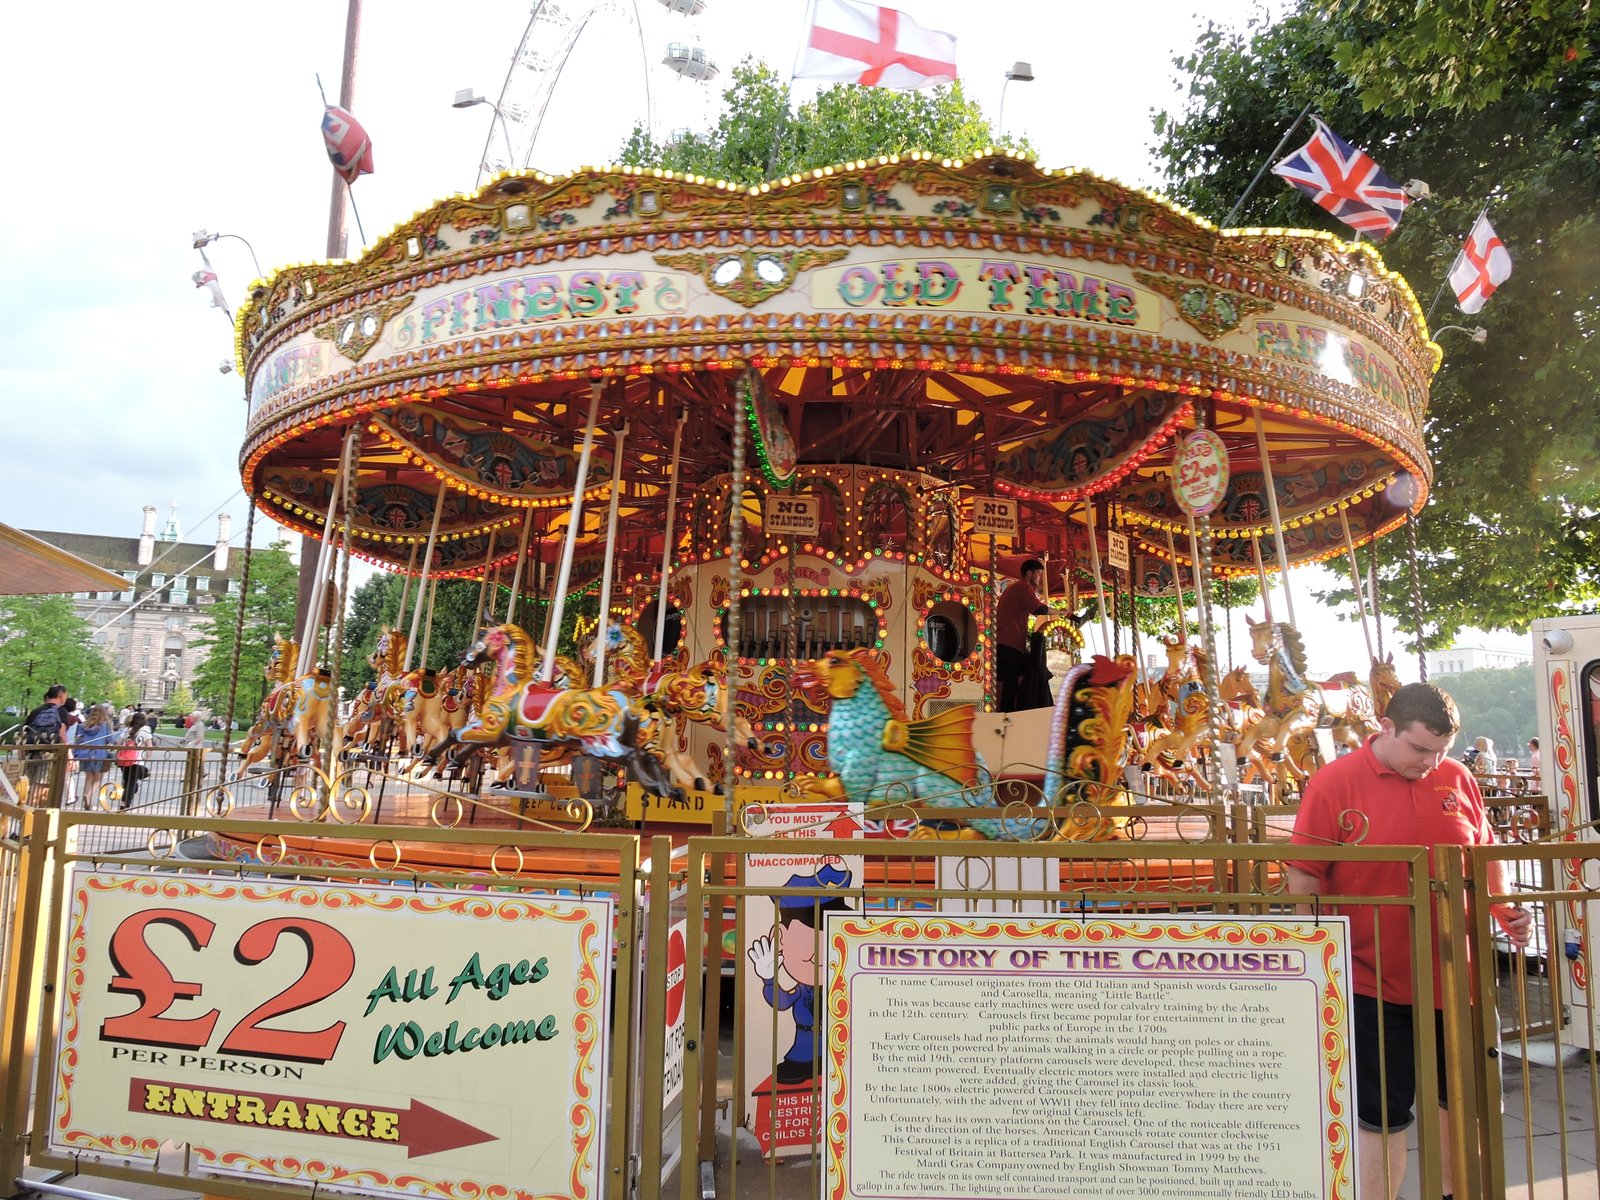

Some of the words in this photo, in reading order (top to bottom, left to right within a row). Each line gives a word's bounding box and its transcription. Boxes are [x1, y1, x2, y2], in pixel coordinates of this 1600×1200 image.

[838, 261, 962, 307] OLD
[981, 259, 1140, 325] TIME
[421, 271, 650, 344] FINEST
[777, 501, 808, 514] NO
[983, 502, 1008, 516] NO
[770, 514, 814, 528] STANDING
[977, 515, 1014, 530] STANDING
[768, 816, 790, 824] YOU
[793, 815, 823, 824] MUST
[793, 829, 816, 838] THIS
[749, 856, 841, 867] UNACCOMPANIED
[867, 945, 998, 968] HISTORY
[1010, 949, 1049, 968] OF
[1060, 951, 1120, 969] THE
[1131, 951, 1299, 972] CAROUSEL
[100, 908, 356, 1065] £2
[363, 965, 438, 1018] All
[446, 952, 550, 1006] Ages
[880, 976, 898, 987] The
[930, 977, 973, 988] Carousel
[976, 978, 1025, 991] originates
[1028, 978, 1052, 989] from
[1055, 978, 1071, 989] the
[1073, 978, 1092, 989] Old
[1096, 979, 1128, 990] Italian
[1131, 979, 1150, 990] and
[1153, 980, 1193, 994] Spanish
[1196, 980, 1227, 991] words
[1229, 980, 1278, 992] Garosello
[980, 988, 1000, 998] and
[1054, 990, 1098, 1003] meaning
[888, 997, 908, 1008] This
[932, 998, 972, 1008] because
[974, 998, 999, 1012] early
[1001, 998, 1048, 1010] machines
[1077, 1000, 1100, 1010] used
[1103, 1000, 1118, 1011] for
[1163, 1002, 1204, 1015] training
[1206, 1002, 1218, 1015] by
[1221, 1002, 1238, 1012] the
[1240, 1002, 1270, 1013] Arabs
[989, 1021, 1020, 1035] public
[1023, 1021, 1050, 1035] parks
[1053, 1021, 1063, 1032] of
[1066, 1022, 1102, 1035] Europe
[1105, 1023, 1115, 1032] in
[1118, 1022, 1134, 1033] the
[1138, 1022, 1168, 1033] 1700s
[373, 1014, 560, 1064] Welcome
[884, 1031, 910, 1045] Early
[912, 1031, 961, 1042] Carousels
[964, 1032, 982, 1043] had
[1056, 1033, 1072, 1044] the
[1074, 1034, 1114, 1045] animals
[1116, 1034, 1148, 1045] would
[1151, 1035, 1176, 1049] hang
[1194, 1035, 1221, 1049] poles
[111, 1046, 169, 1066] PER
[179, 1053, 304, 1080] PERSON
[872, 1052, 885, 1066] By
[888, 1052, 904, 1063] the
[907, 1052, 926, 1063] mid
[958, 1055, 997, 1068] century
[1000, 1054, 1044, 1068] platform
[1046, 1055, 1092, 1066] carousels
[1178, 1057, 1205, 1068] these
[1208, 1057, 1256, 1069] machines
[1022, 1077, 1054, 1089] giving
[1056, 1076, 1072, 1087] the
[1075, 1076, 1119, 1087] Carousel
[1122, 1078, 1135, 1087] its
[1137, 1077, 1170, 1088] classic
[774, 1096, 798, 1106] HIS
[144, 1083, 400, 1140] ENTRANCE
[1012, 1105, 1030, 1116] few
[1032, 1106, 1071, 1120] original
[1074, 1106, 1123, 1118] Carousels
[785, 1117, 810, 1128] FOR
[894, 1124, 902, 1133] is
[905, 1123, 922, 1134] the
[924, 1123, 969, 1134] direction
[972, 1124, 982, 1135] of
[985, 1124, 1002, 1135] the
[1042, 1125, 1091, 1137] American
[1093, 1126, 1143, 1138] Carousels
[1146, 1129, 1176, 1138] rotate
[1178, 1129, 1218, 1139] counter
[1220, 1129, 1270, 1140] clockwise
[884, 1134, 904, 1144] This
[907, 1134, 953, 1145] Carousel
[954, 1136, 962, 1146] is
[974, 1135, 1008, 1149] replica
[1010, 1136, 1020, 1146] of
[1032, 1136, 1086, 1148] traditional
[1089, 1137, 1127, 1151] English
[1129, 1138, 1174, 1149] Carousel
[1177, 1139, 1198, 1150] that
[1223, 1141, 1233, 1150] at
[1236, 1140, 1253, 1151] the
[1257, 1140, 1280, 1151] 1951
[895, 1146, 932, 1157] Festival
[935, 1146, 945, 1157] of
[949, 1146, 984, 1158] Britain
[986, 1148, 996, 1158] at
[1000, 1147, 1047, 1159] Battersea
[1079, 1149, 1086, 1160] It
[1112, 1150, 1182, 1161] manufactured
[1185, 1152, 1196, 1162] in
[1200, 1151, 1225, 1162] 1999
[1228, 1152, 1240, 1165] by
[1243, 1152, 1260, 1163] the
